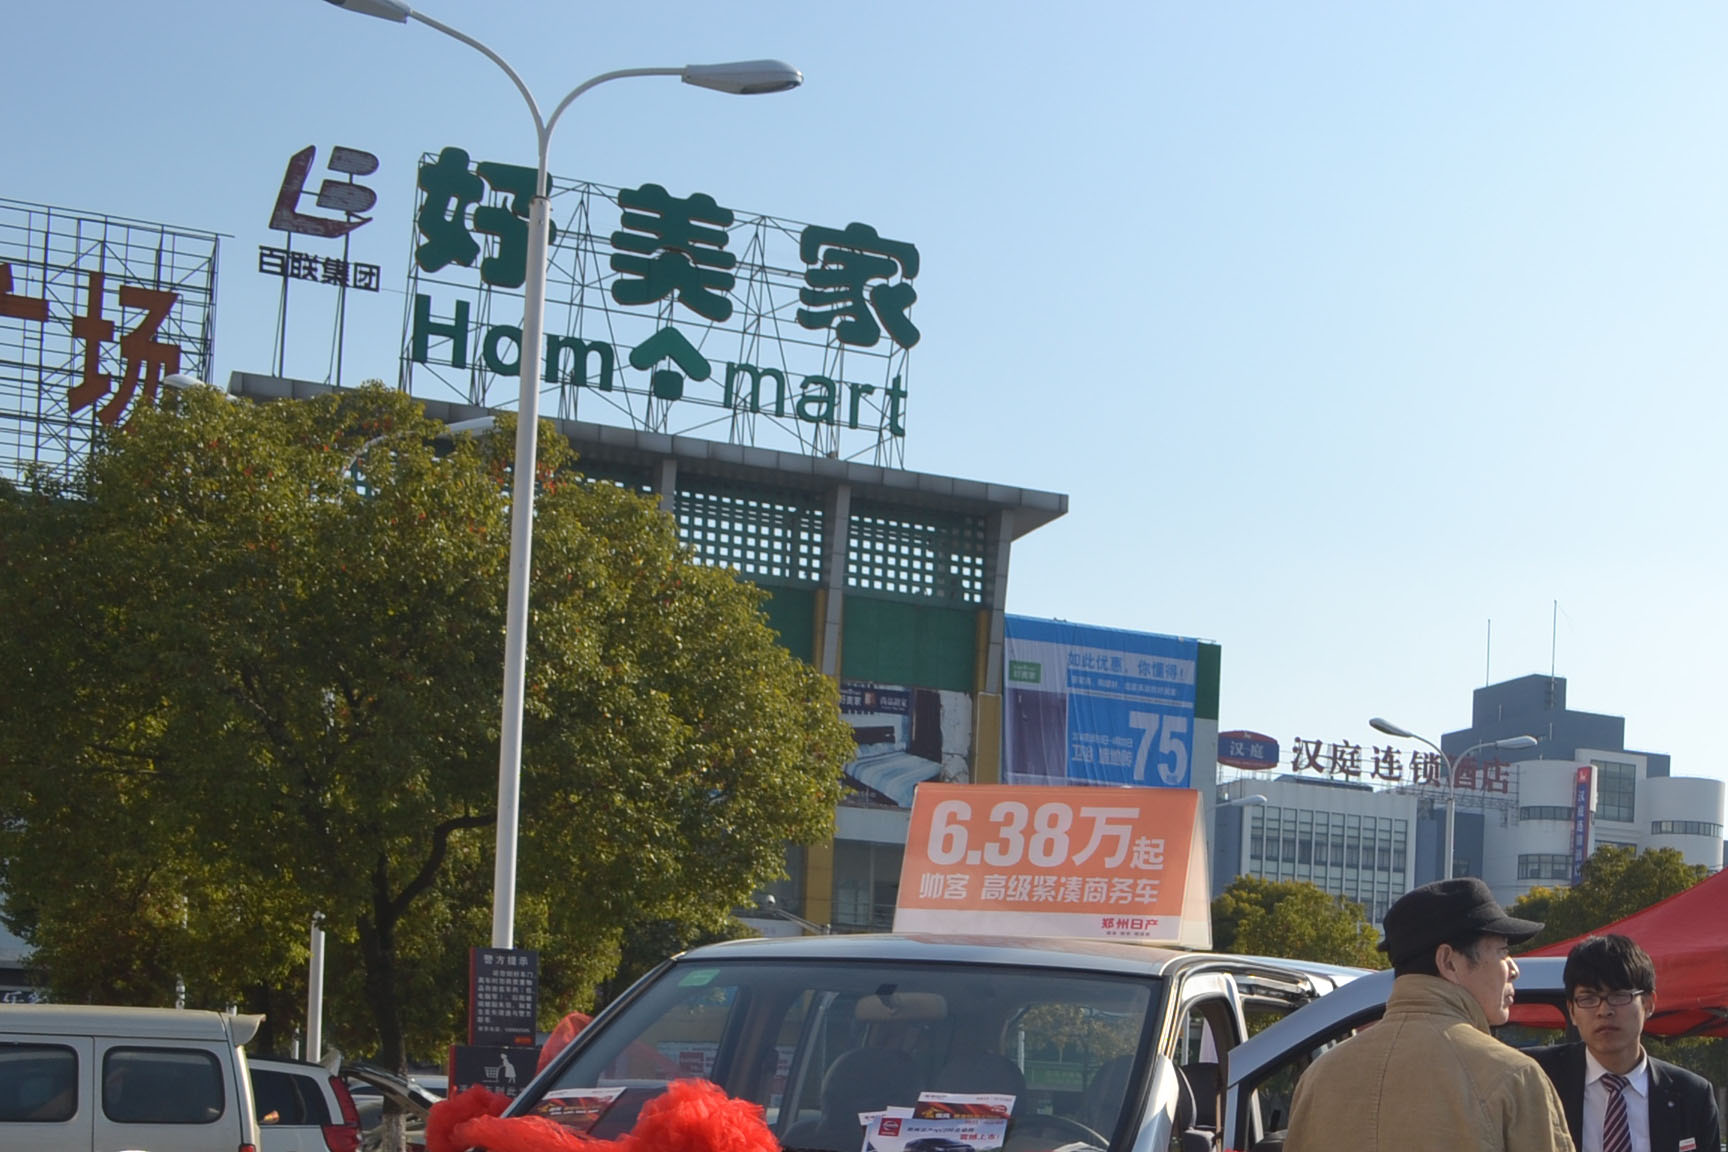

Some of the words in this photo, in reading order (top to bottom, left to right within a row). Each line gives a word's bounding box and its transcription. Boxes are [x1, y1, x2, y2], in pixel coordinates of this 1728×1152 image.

[258, 245, 381, 293] 百联集团
[413, 146, 921, 350] 好美家
[1129, 711, 1188, 785] 75
[1230, 740, 1264, 759] 汉庭
[1291, 737, 1513, 794] 汉庭连锁酒店
[927, 800, 1166, 870] 6.38万起
[919, 873, 970, 900] 帅客
[980, 874, 1161, 905] 高级紧凑商务车
[1101, 917, 1159, 930] 郑州日产
